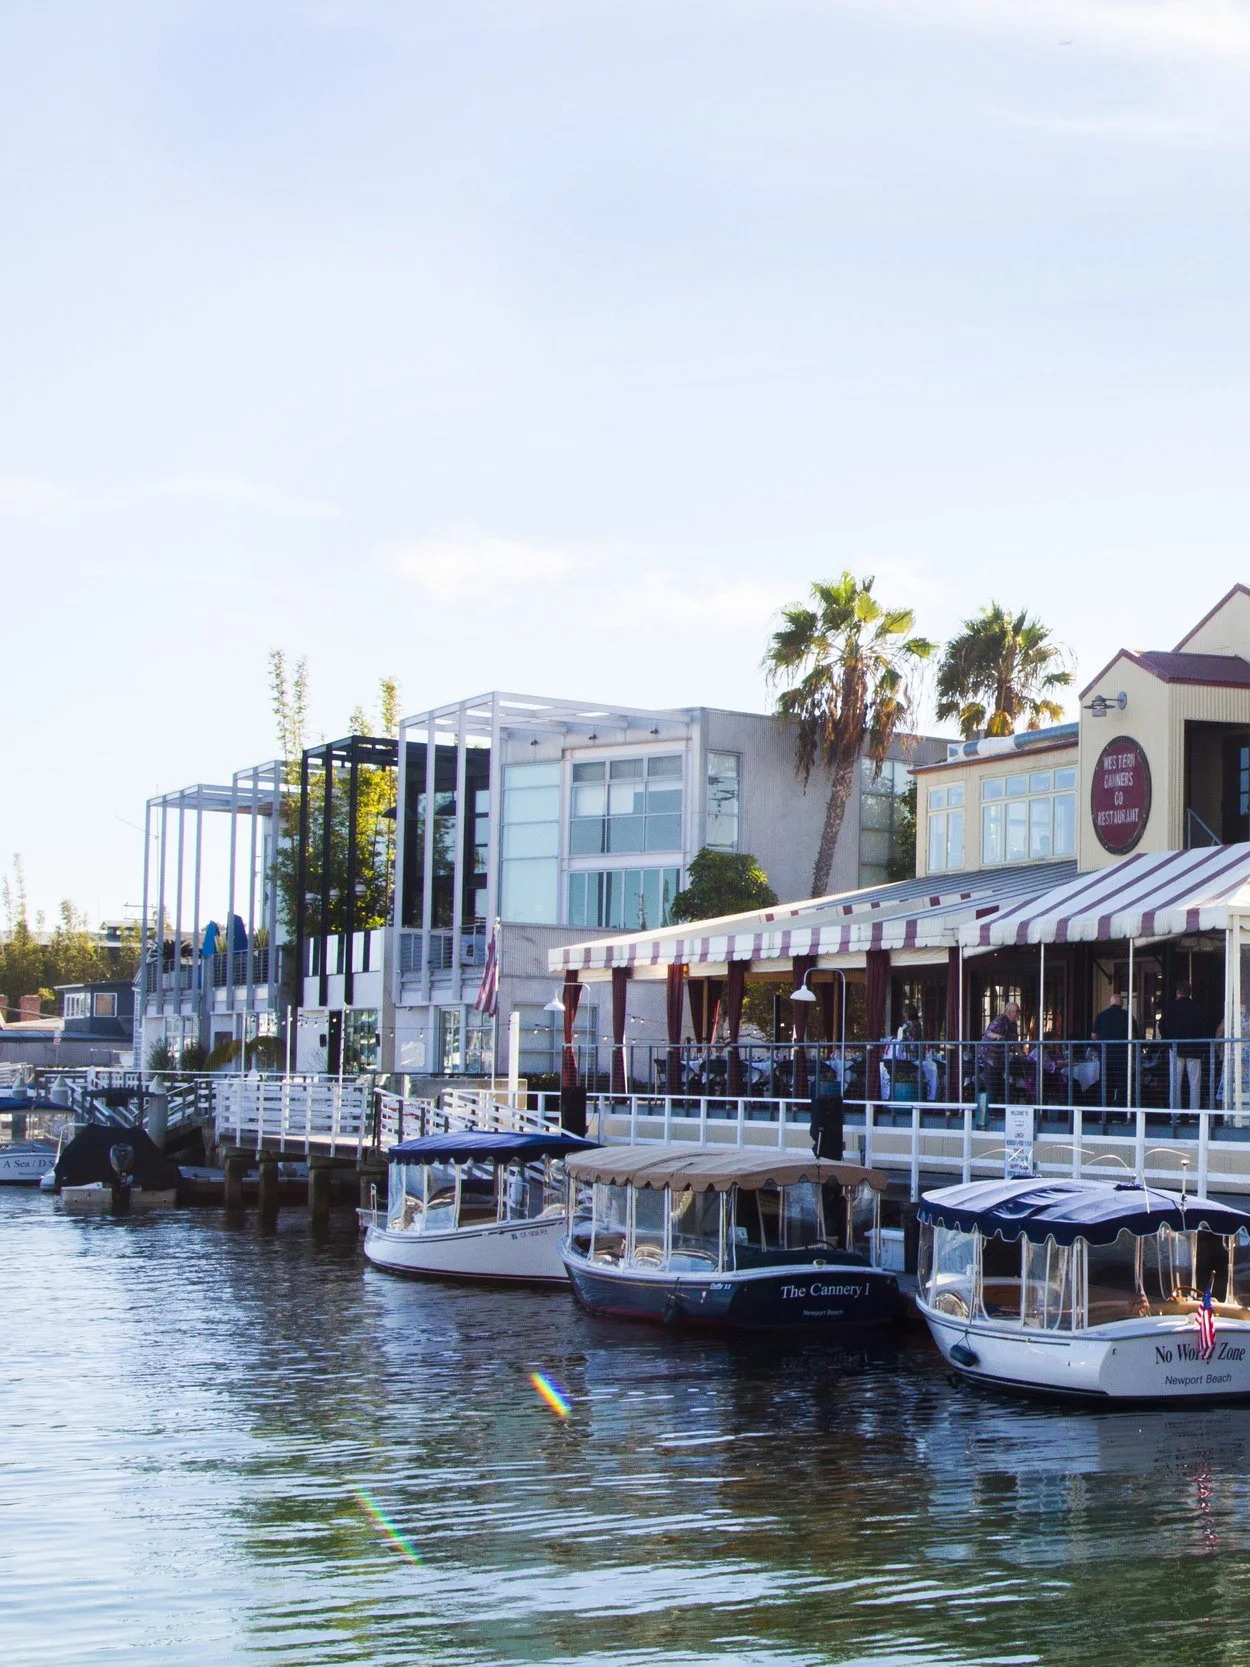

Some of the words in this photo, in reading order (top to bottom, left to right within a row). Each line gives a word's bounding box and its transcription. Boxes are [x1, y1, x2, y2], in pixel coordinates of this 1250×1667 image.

[1103, 753, 1135, 770] WESTERN
[1104, 771, 1133, 789] CANNERS
[1114, 791, 1124, 806] CO
[1097, 807, 1139, 826] RESTAURANT
[780, 1285, 806, 1299] The
[810, 1283, 863, 1299] Cannery
[802, 1309, 827, 1317] Newport
[1155, 1345, 1173, 1364] No
[1217, 1342, 1246, 1362] Zone
[1165, 1375, 1203, 1387] Newport
[1205, 1374, 1232, 1384] Beach
